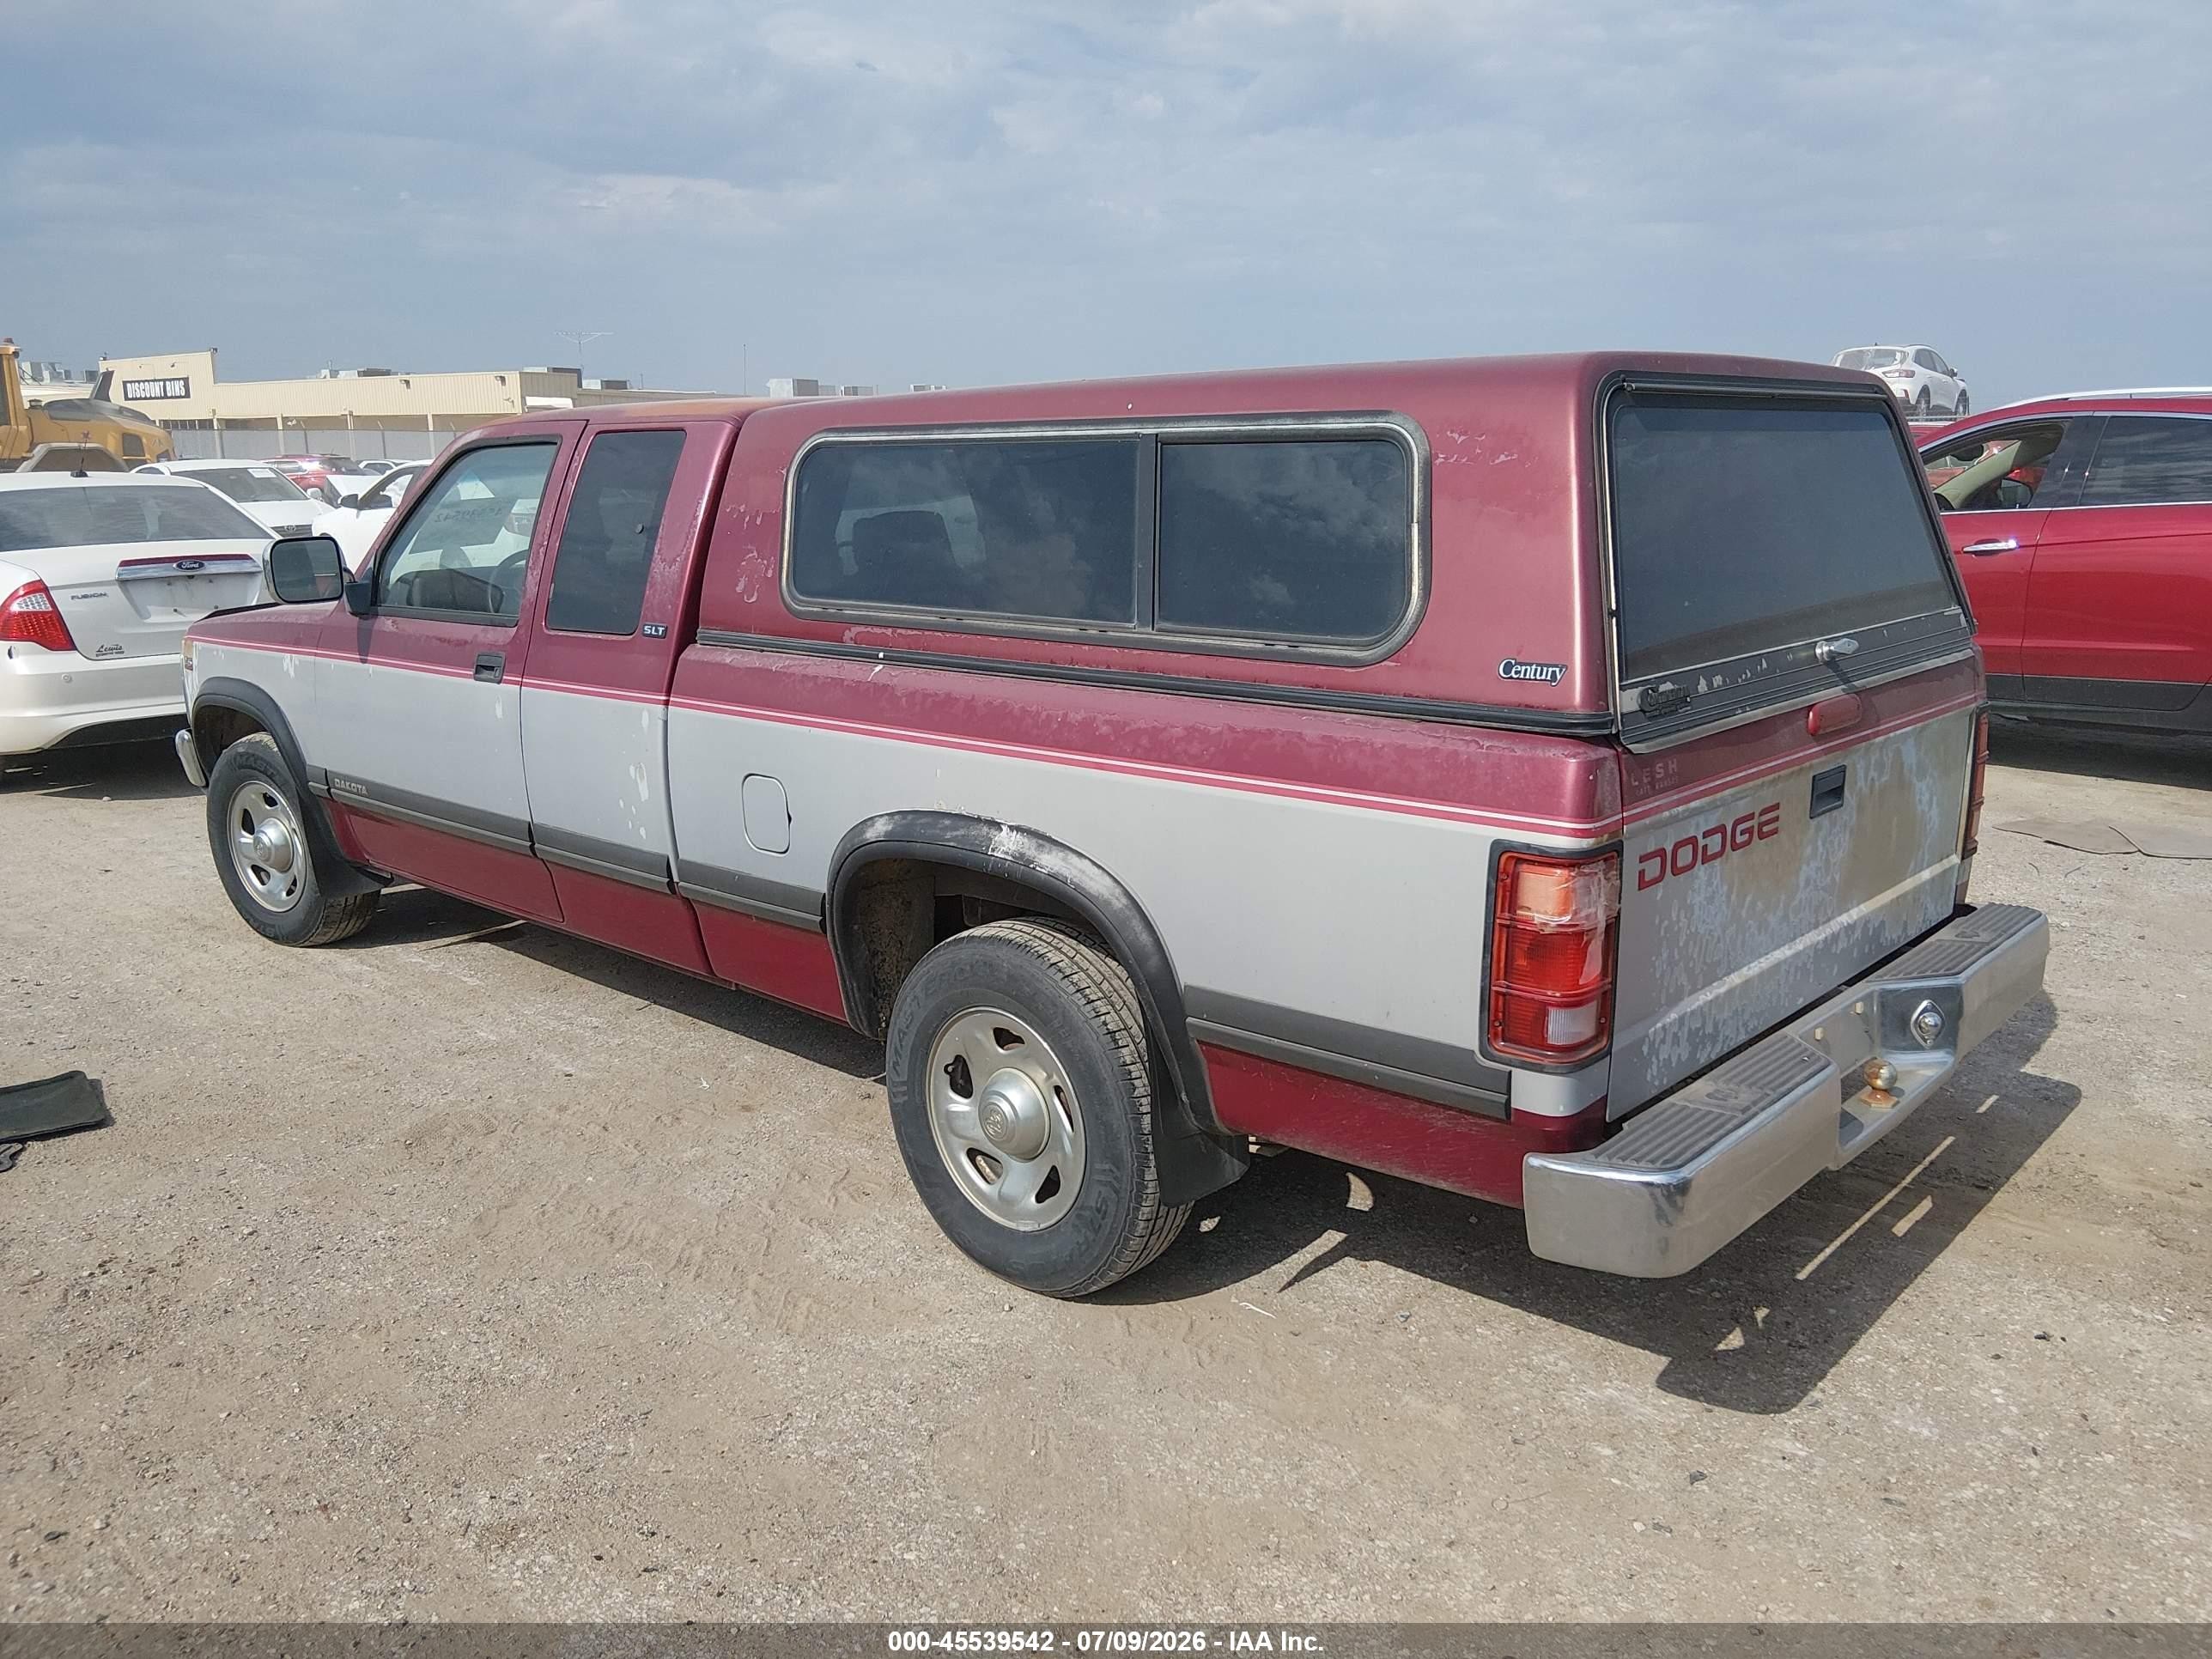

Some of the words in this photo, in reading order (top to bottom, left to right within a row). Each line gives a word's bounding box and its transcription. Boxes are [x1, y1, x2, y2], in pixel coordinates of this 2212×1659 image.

[126, 380, 164, 398] DISCOUNT
[166, 380, 185, 397] BINS
[71, 592, 108, 600] FUSION
[643, 625, 665, 635] SLT
[96, 644, 123, 653] Lewis
[1498, 659, 1566, 686] Century
[334, 778, 368, 795] DAKOTA
[1638, 803, 1780, 891] DODGE
